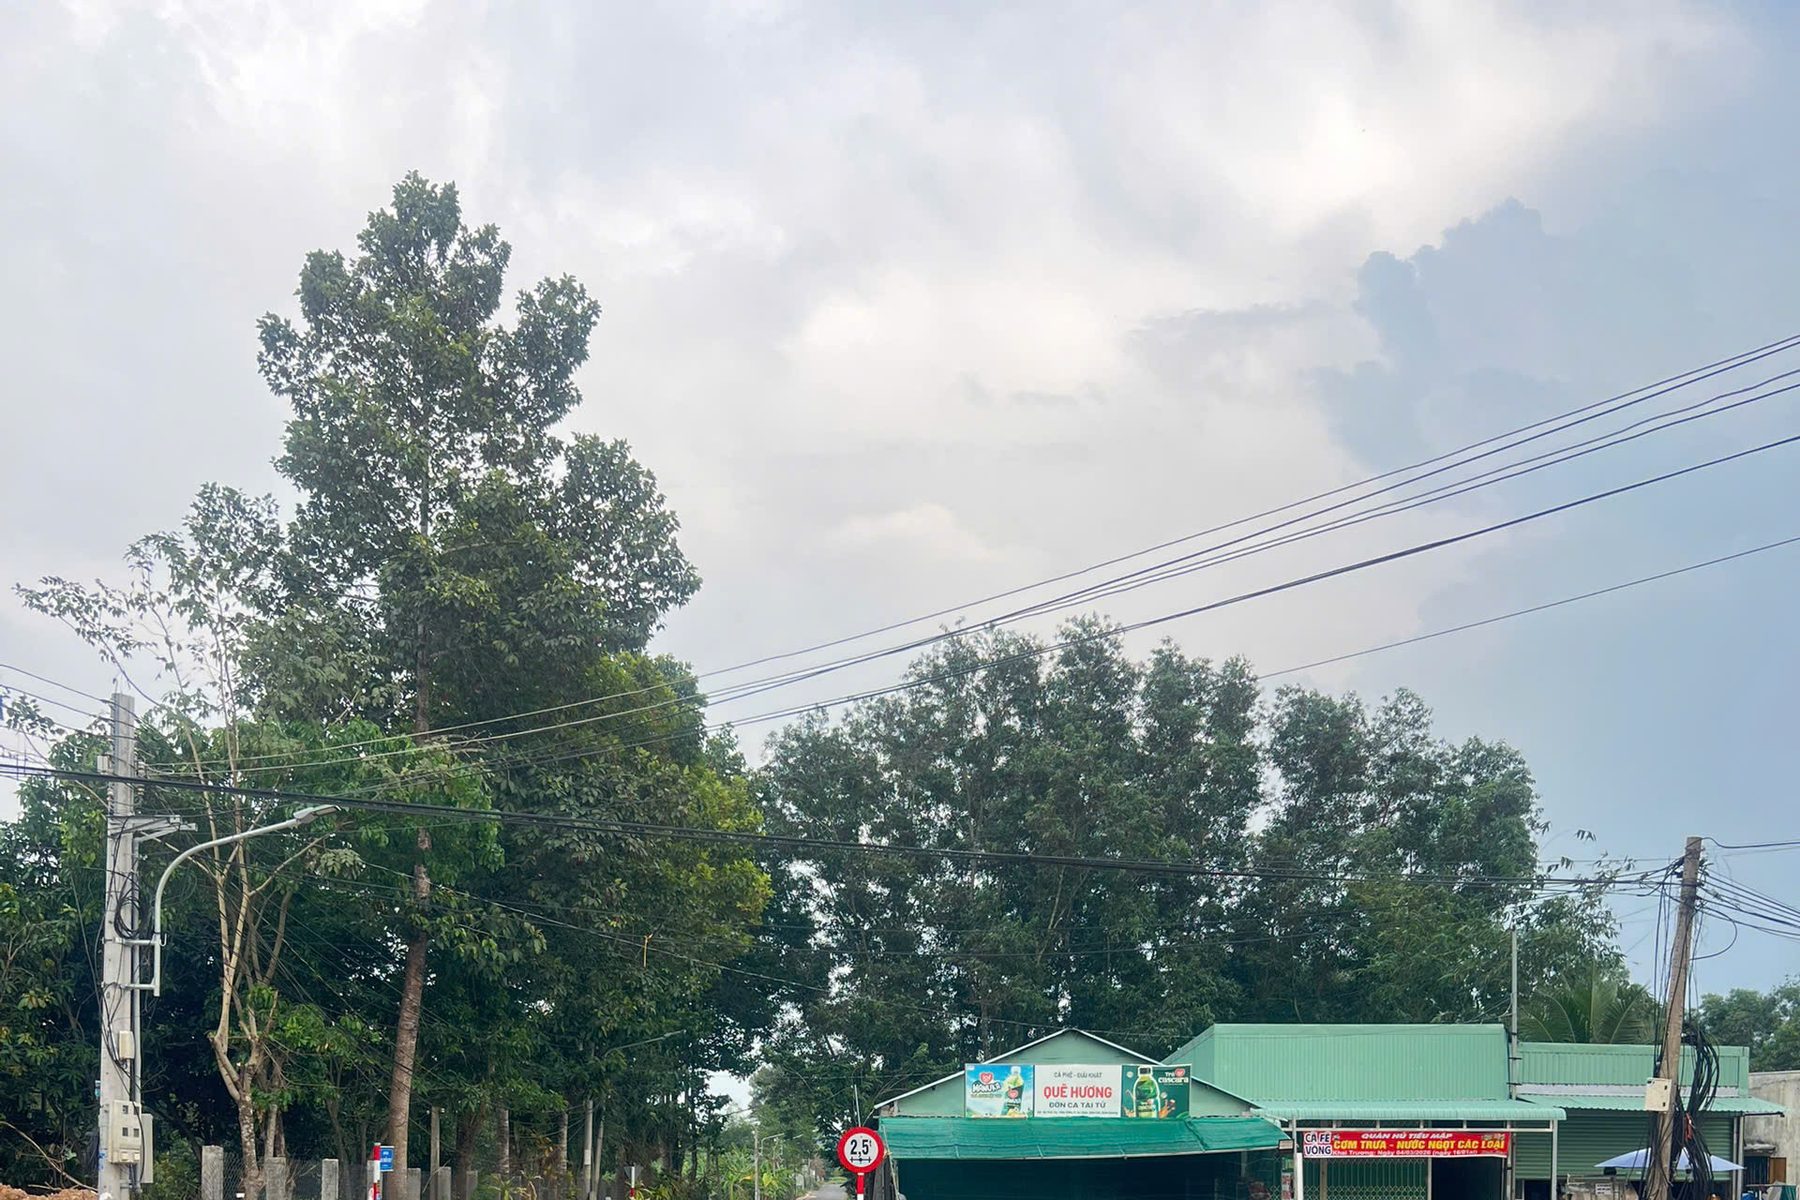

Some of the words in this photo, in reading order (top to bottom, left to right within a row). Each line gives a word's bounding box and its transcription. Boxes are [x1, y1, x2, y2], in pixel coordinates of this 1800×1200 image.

[1043, 1083, 1068, 1099] QUÊ
[1070, 1085, 1112, 1098] HƯƠNG
[1333, 1140, 1357, 1149] CƠM
[1360, 1140, 1386, 1149] TRƯA
[1396, 1139, 1425, 1149] NƯỚC
[1428, 1140, 1455, 1151] NGỌT
[1457, 1138, 1478, 1149] CÁC
[1481, 1139, 1505, 1150] LOẠI
